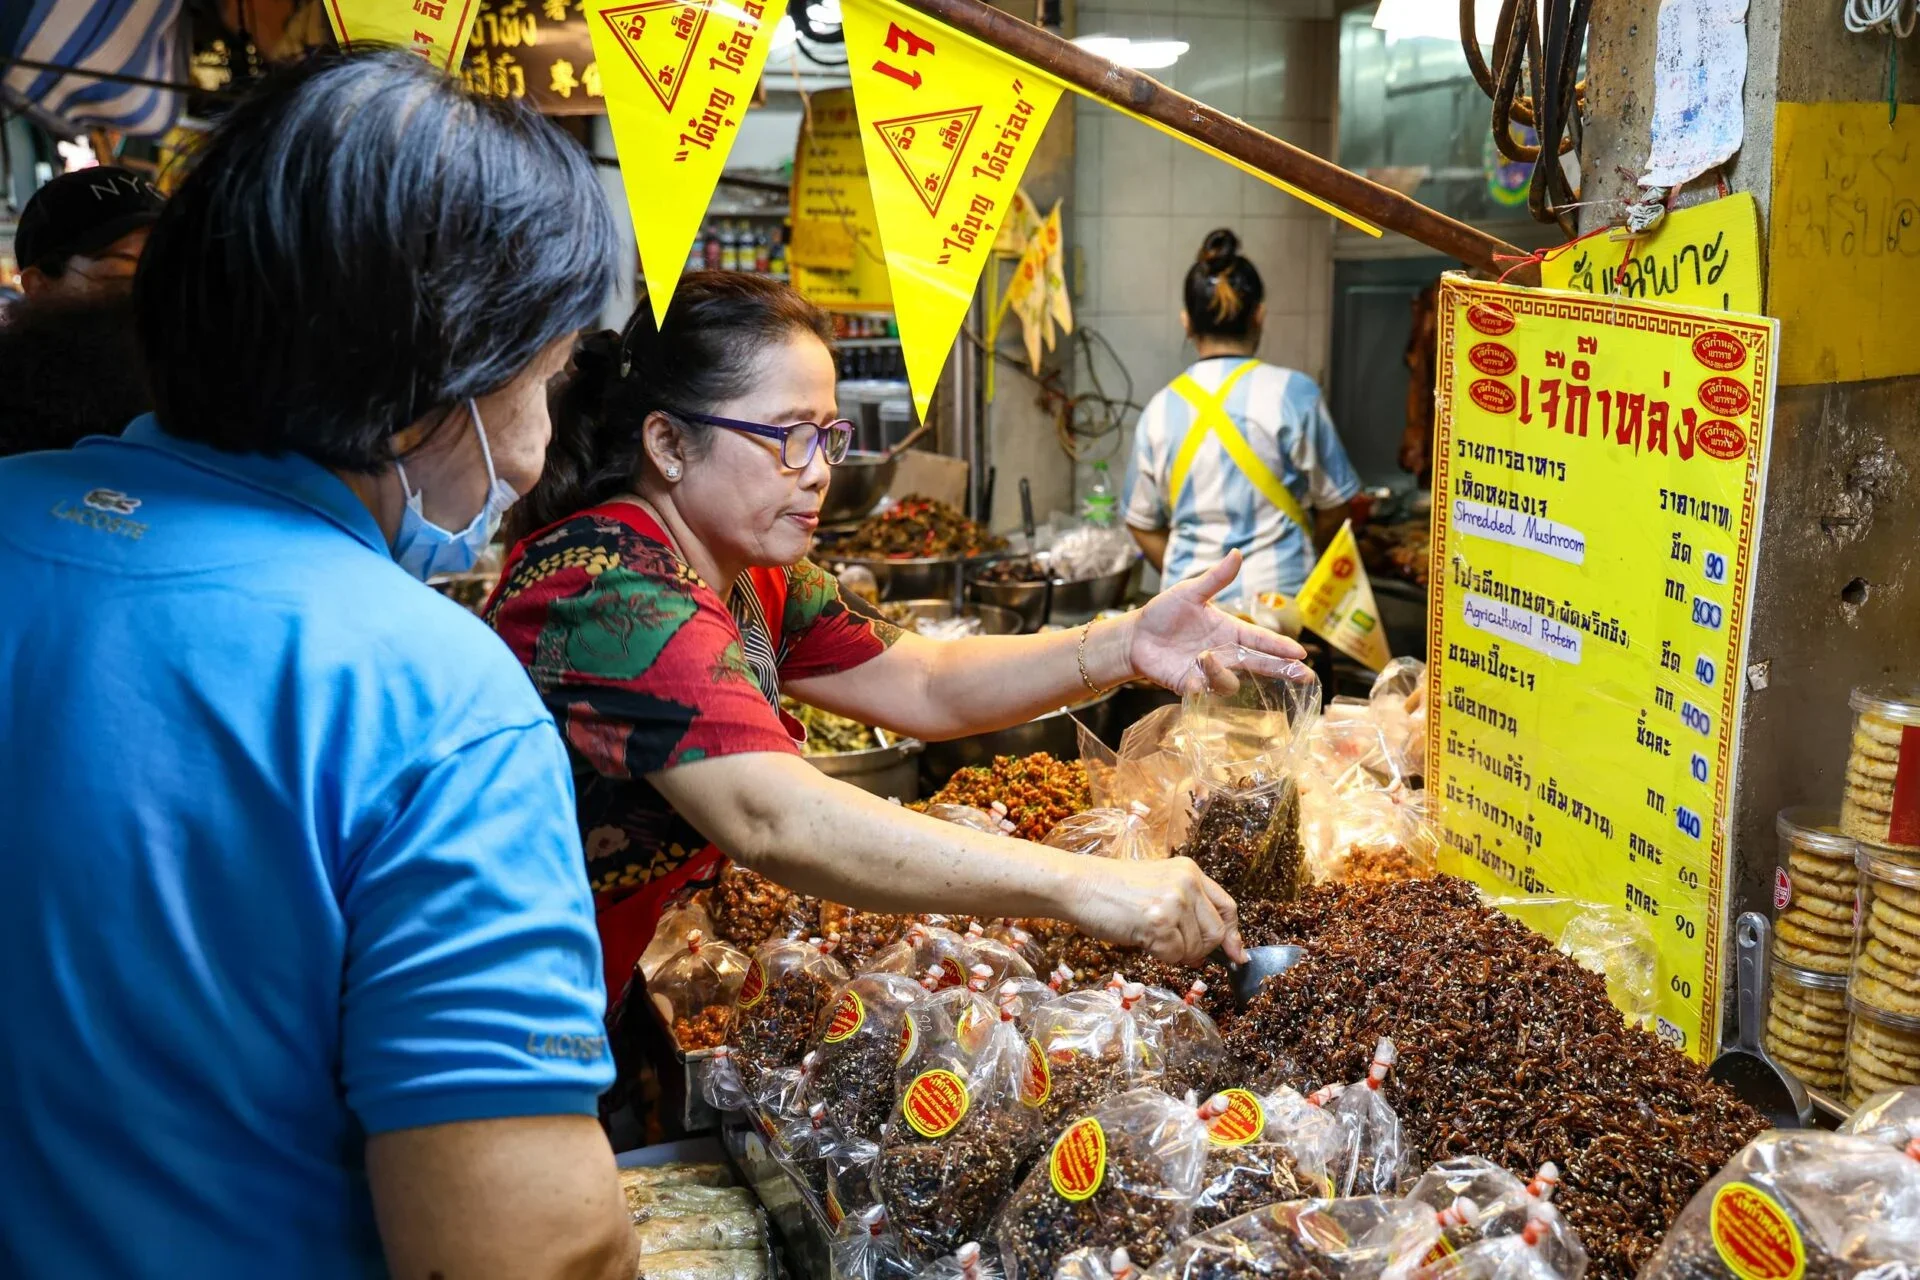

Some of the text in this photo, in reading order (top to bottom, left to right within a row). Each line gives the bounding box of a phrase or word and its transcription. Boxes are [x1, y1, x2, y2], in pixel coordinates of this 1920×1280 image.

[872, 21, 935, 90] เจ
[1457, 439, 1566, 481] รายการอาหาร
[1455, 470, 1547, 518] เห็ดหยองเจ
[1453, 500, 1585, 555] Shredded Mushroom
[1705, 552, 1724, 580] 90
[1665, 578, 1687, 604] กก.
[1464, 600, 1577, 653] Agricultural Protein
[1692, 597, 1722, 629] 800
[1695, 657, 1715, 685] 40
[1655, 686, 1676, 713] กก.
[1681, 701, 1711, 736] 400
[1691, 753, 1708, 783] 10
[1678, 866, 1698, 889] 60
[1675, 914, 1695, 939] 90
[1671, 974, 1691, 999] 60
